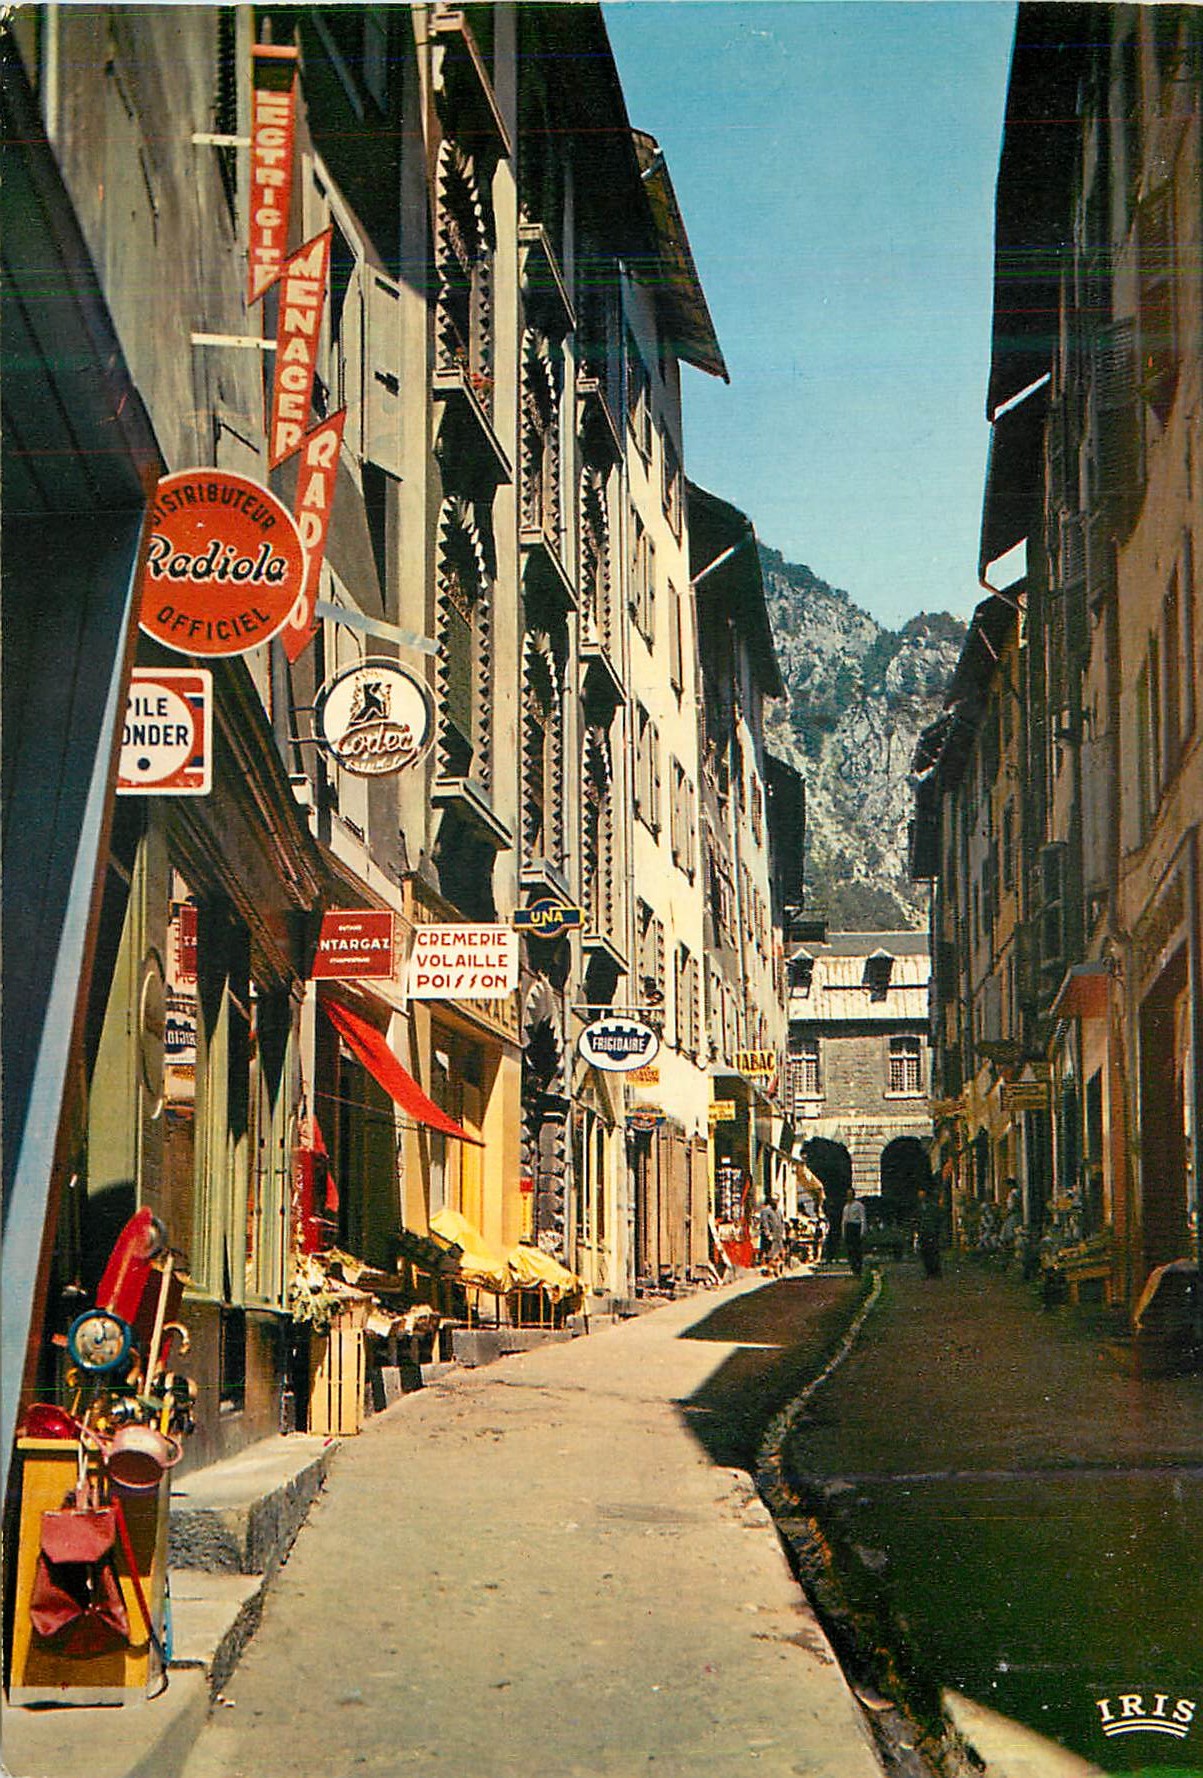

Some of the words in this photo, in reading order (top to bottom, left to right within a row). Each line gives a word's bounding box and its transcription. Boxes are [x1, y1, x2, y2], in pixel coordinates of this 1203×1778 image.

[254, 90, 291, 294] LECTRICITE
[276, 240, 324, 458] MENAGER
[149, 533, 288, 585] Radiola
[156, 605, 270, 641] OFFICIEL
[121, 724, 189, 746] ONDER
[529, 908, 565, 927] UNA
[319, 937, 391, 952] NTARGAZ
[417, 932, 508, 947] CREMERIE
[416, 953, 509, 968] VOLAILLE
[416, 973, 508, 989] POISSON
[592, 1035, 647, 1053] FRIGIDAIRE
[735, 1051, 775, 1071] TABAC
